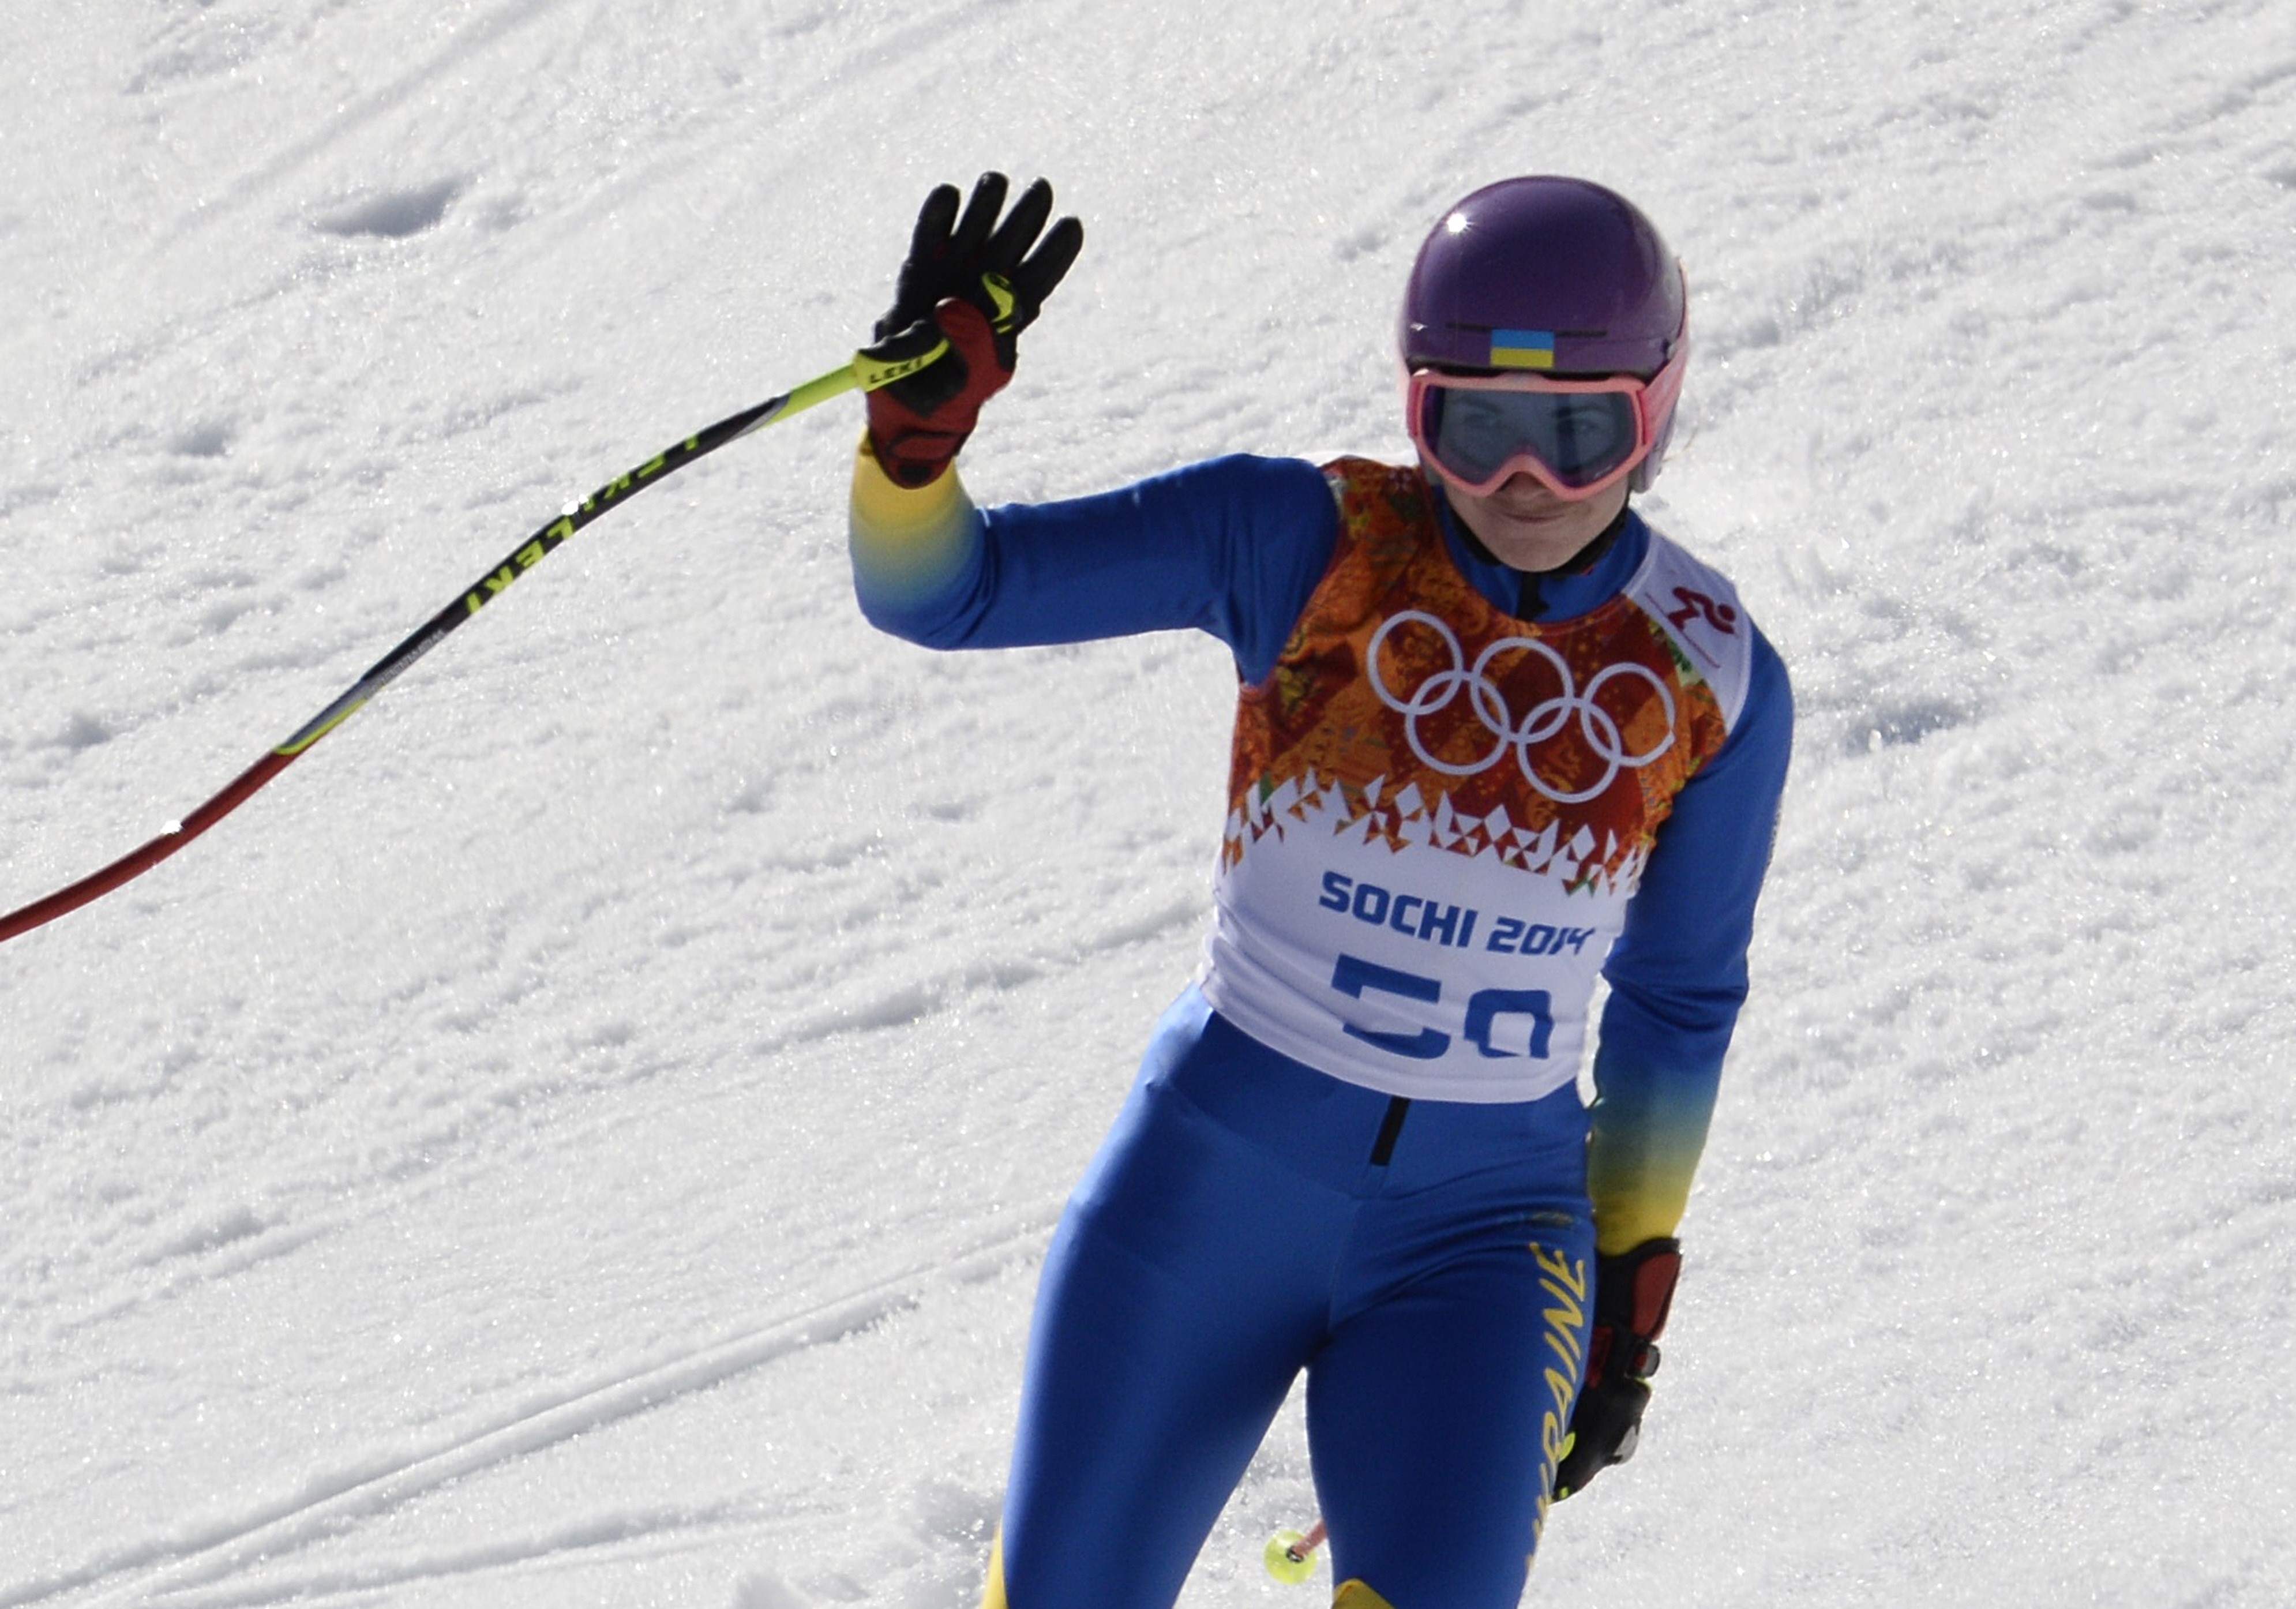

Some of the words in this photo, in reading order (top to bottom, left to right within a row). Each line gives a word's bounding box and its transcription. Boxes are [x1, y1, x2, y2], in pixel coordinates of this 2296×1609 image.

[870, 355, 924, 384] LEKI
[1319, 871, 1478, 948] SOCHI
[1486, 916, 1596, 956] 2014
